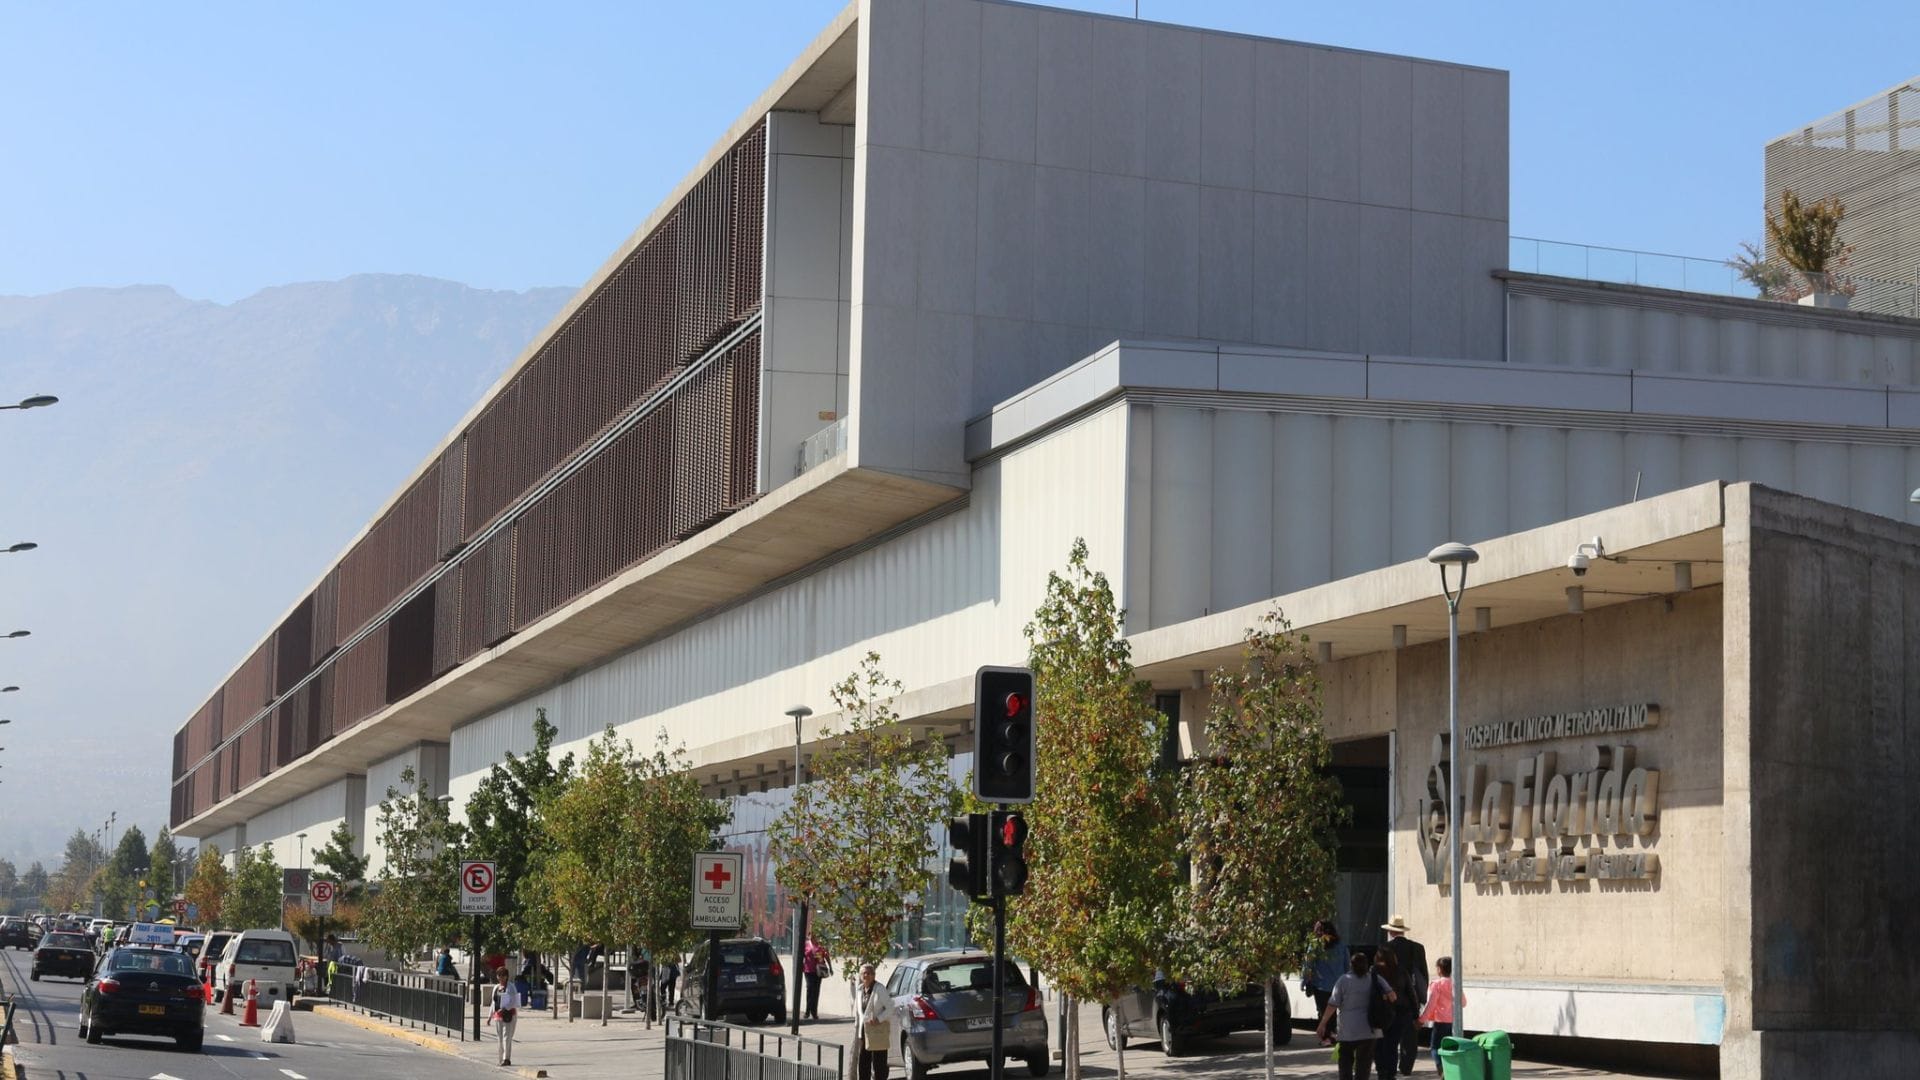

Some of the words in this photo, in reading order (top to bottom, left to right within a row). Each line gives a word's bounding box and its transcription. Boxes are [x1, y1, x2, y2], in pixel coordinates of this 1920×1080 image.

[1463, 723, 1509, 749] HOSPITAL
[1511, 716, 1551, 742] CLINICO
[1553, 703, 1649, 738] METROPOLITANO
[1463, 765, 1510, 843] La
[1512, 745, 1657, 839] Florida
[472, 869, 484, 888] E
[704, 896, 730, 904] ACCESO
[708, 905, 725, 914] SOLO
[695, 915, 738, 924] AMBULANCIA
